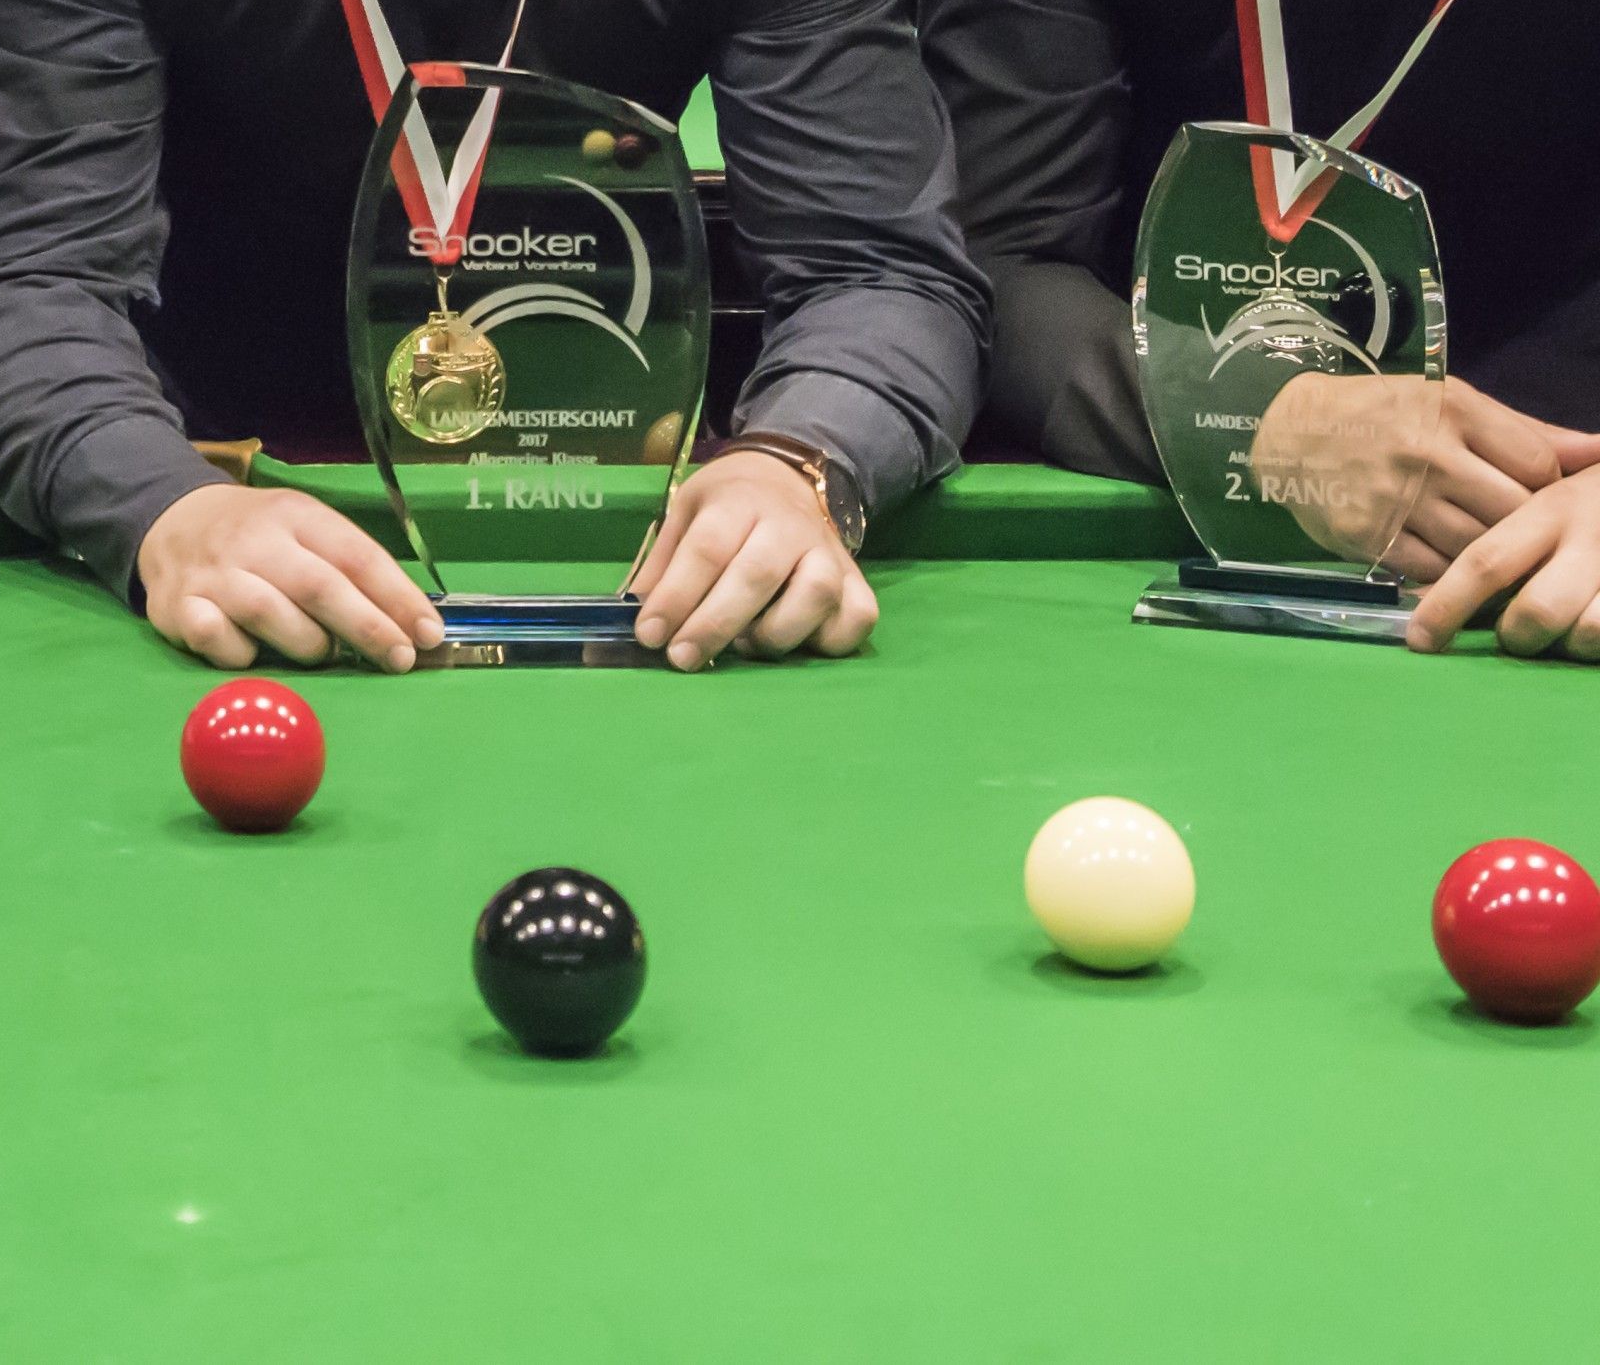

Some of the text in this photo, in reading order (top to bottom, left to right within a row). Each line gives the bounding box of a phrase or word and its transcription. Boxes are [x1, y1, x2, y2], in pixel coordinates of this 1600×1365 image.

[409, 226, 596, 257] Snooker
[1175, 255, 1341, 287] Snooker
[518, 434, 549, 447] 2017
[466, 477, 604, 510] 1. RANG
[1224, 472, 1349, 507] 2. RANG
